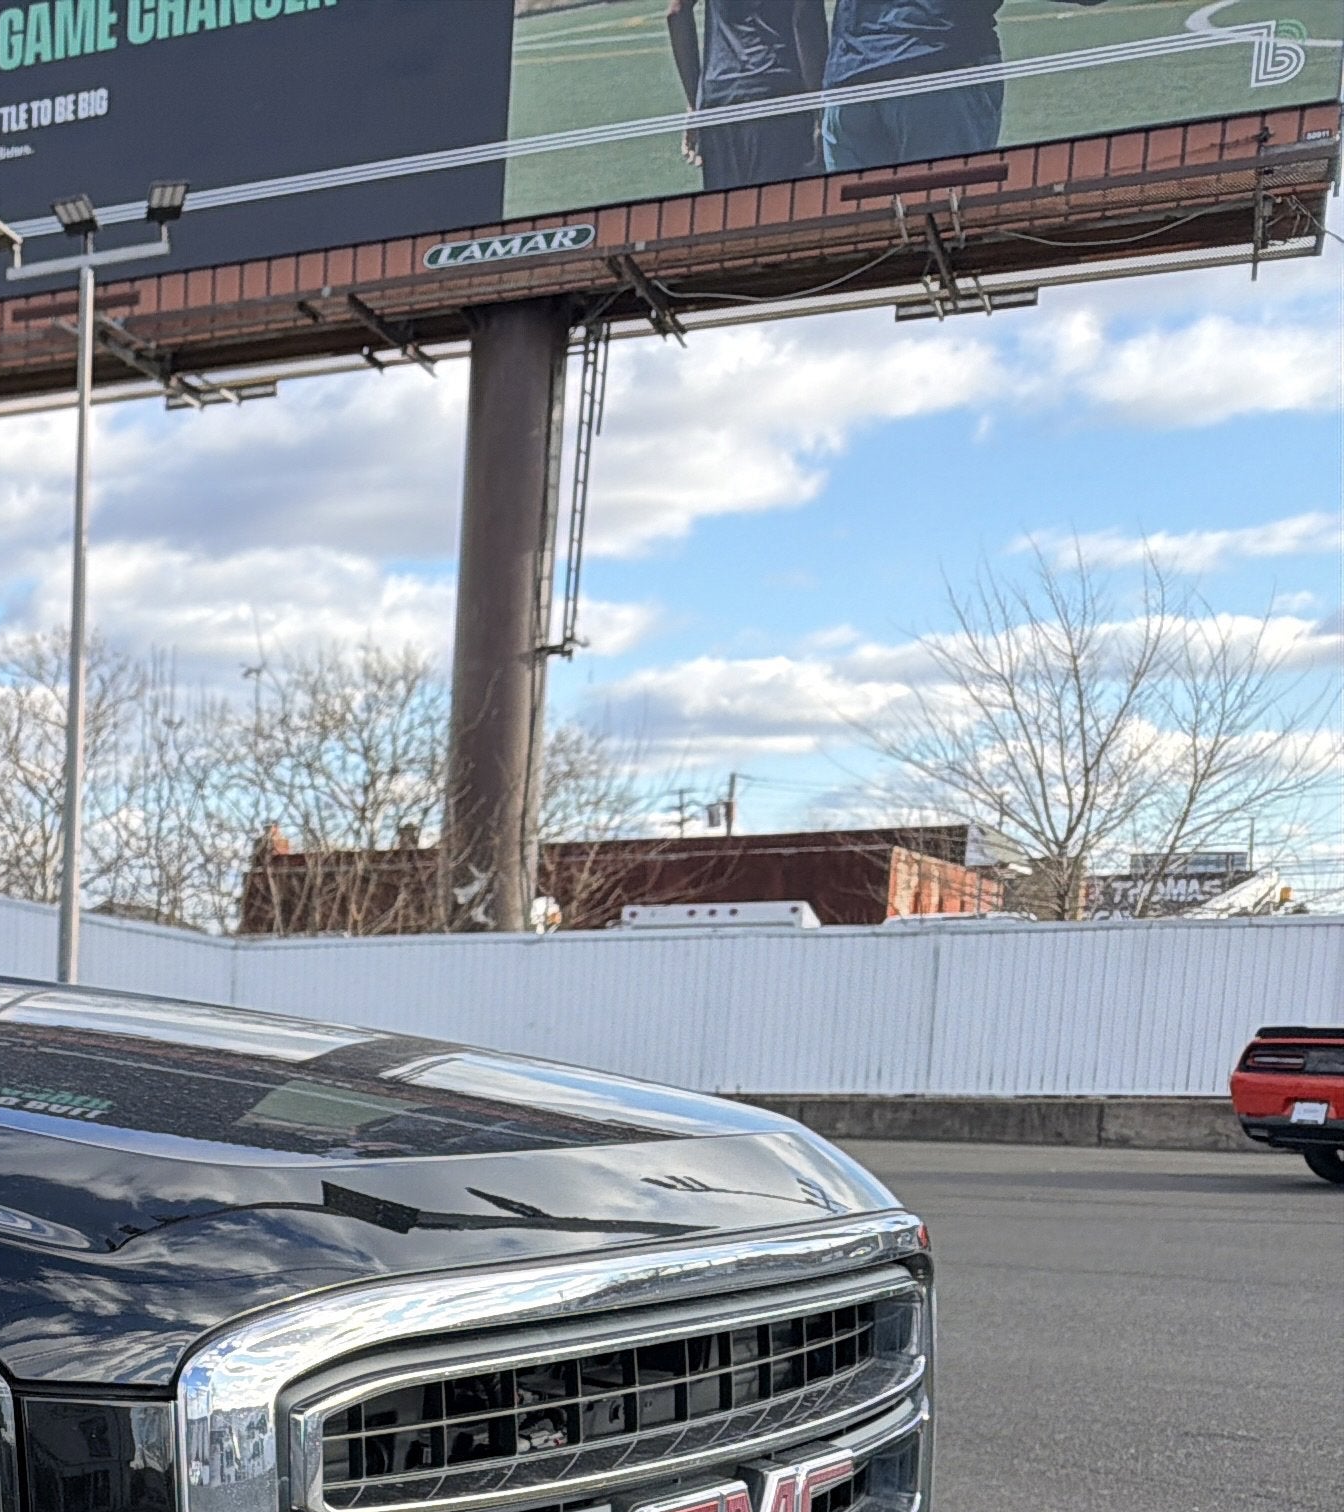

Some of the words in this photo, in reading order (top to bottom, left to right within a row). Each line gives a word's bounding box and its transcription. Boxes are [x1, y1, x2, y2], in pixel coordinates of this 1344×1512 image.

[30, 98, 53, 128] TO
[54, 94, 76, 124] BE
[77, 87, 109, 119] BIG
[436, 230, 577, 266] LAMAR
